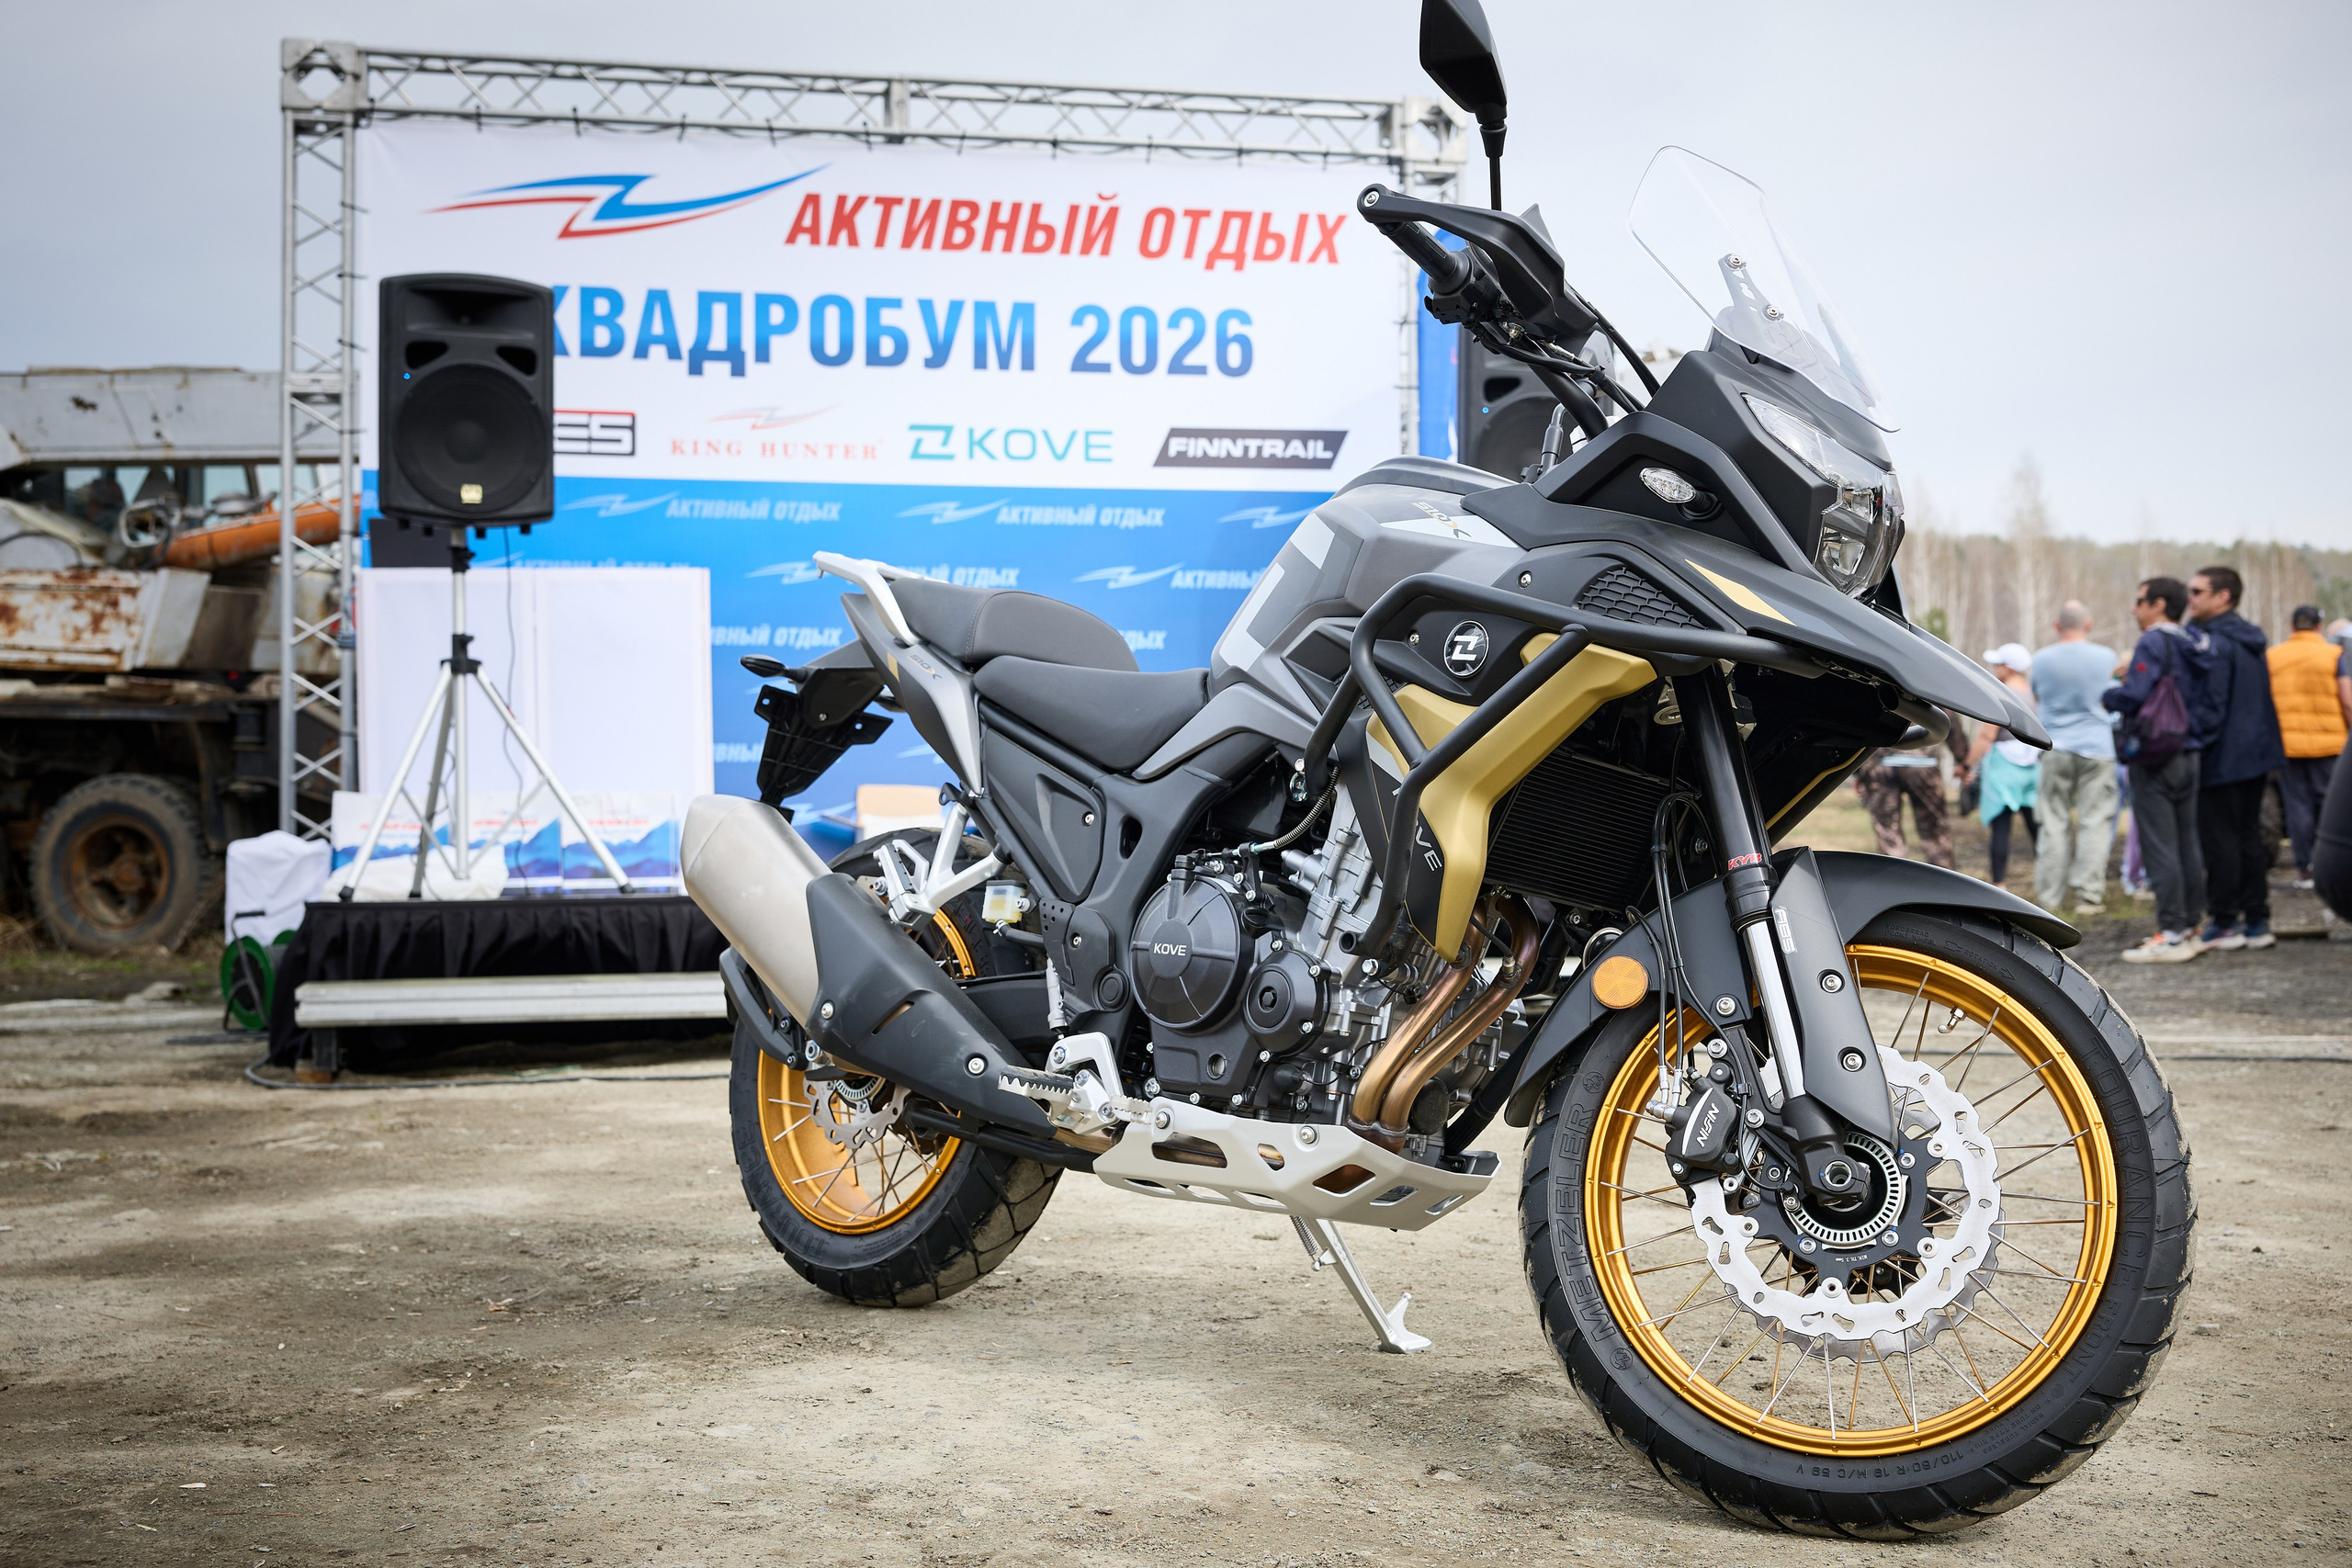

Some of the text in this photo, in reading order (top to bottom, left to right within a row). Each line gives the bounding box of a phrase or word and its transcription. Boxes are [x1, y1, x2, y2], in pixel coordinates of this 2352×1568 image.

[785, 192, 1348, 272] АКТИВНЫЙ ОТДЫХ
[1070, 304, 1254, 378] 2026
[671, 439, 877, 460] KING HUNTER
[967, 426, 1114, 462] KOVE
[1167, 435, 1335, 460] FINNTRAIL
[665, 497, 842, 524] АКТИВНЫЙ ОТДЫХ
[995, 503, 1166, 529] АКТИВНЫЙ ОТДЫХ
[774, 626, 842, 649] ОТДЫХ
[1728, 853, 1762, 871] KYB
[1775, 908, 1796, 954] ABS
[1885, 923, 1930, 937] VORDERRAD
[1153, 942, 1187, 957] KOVE
[2080, 1036, 2154, 1292] TOURANCE
[1555, 1103, 1617, 1343] METZELER
[2066, 1296, 2120, 1383] FRONT
